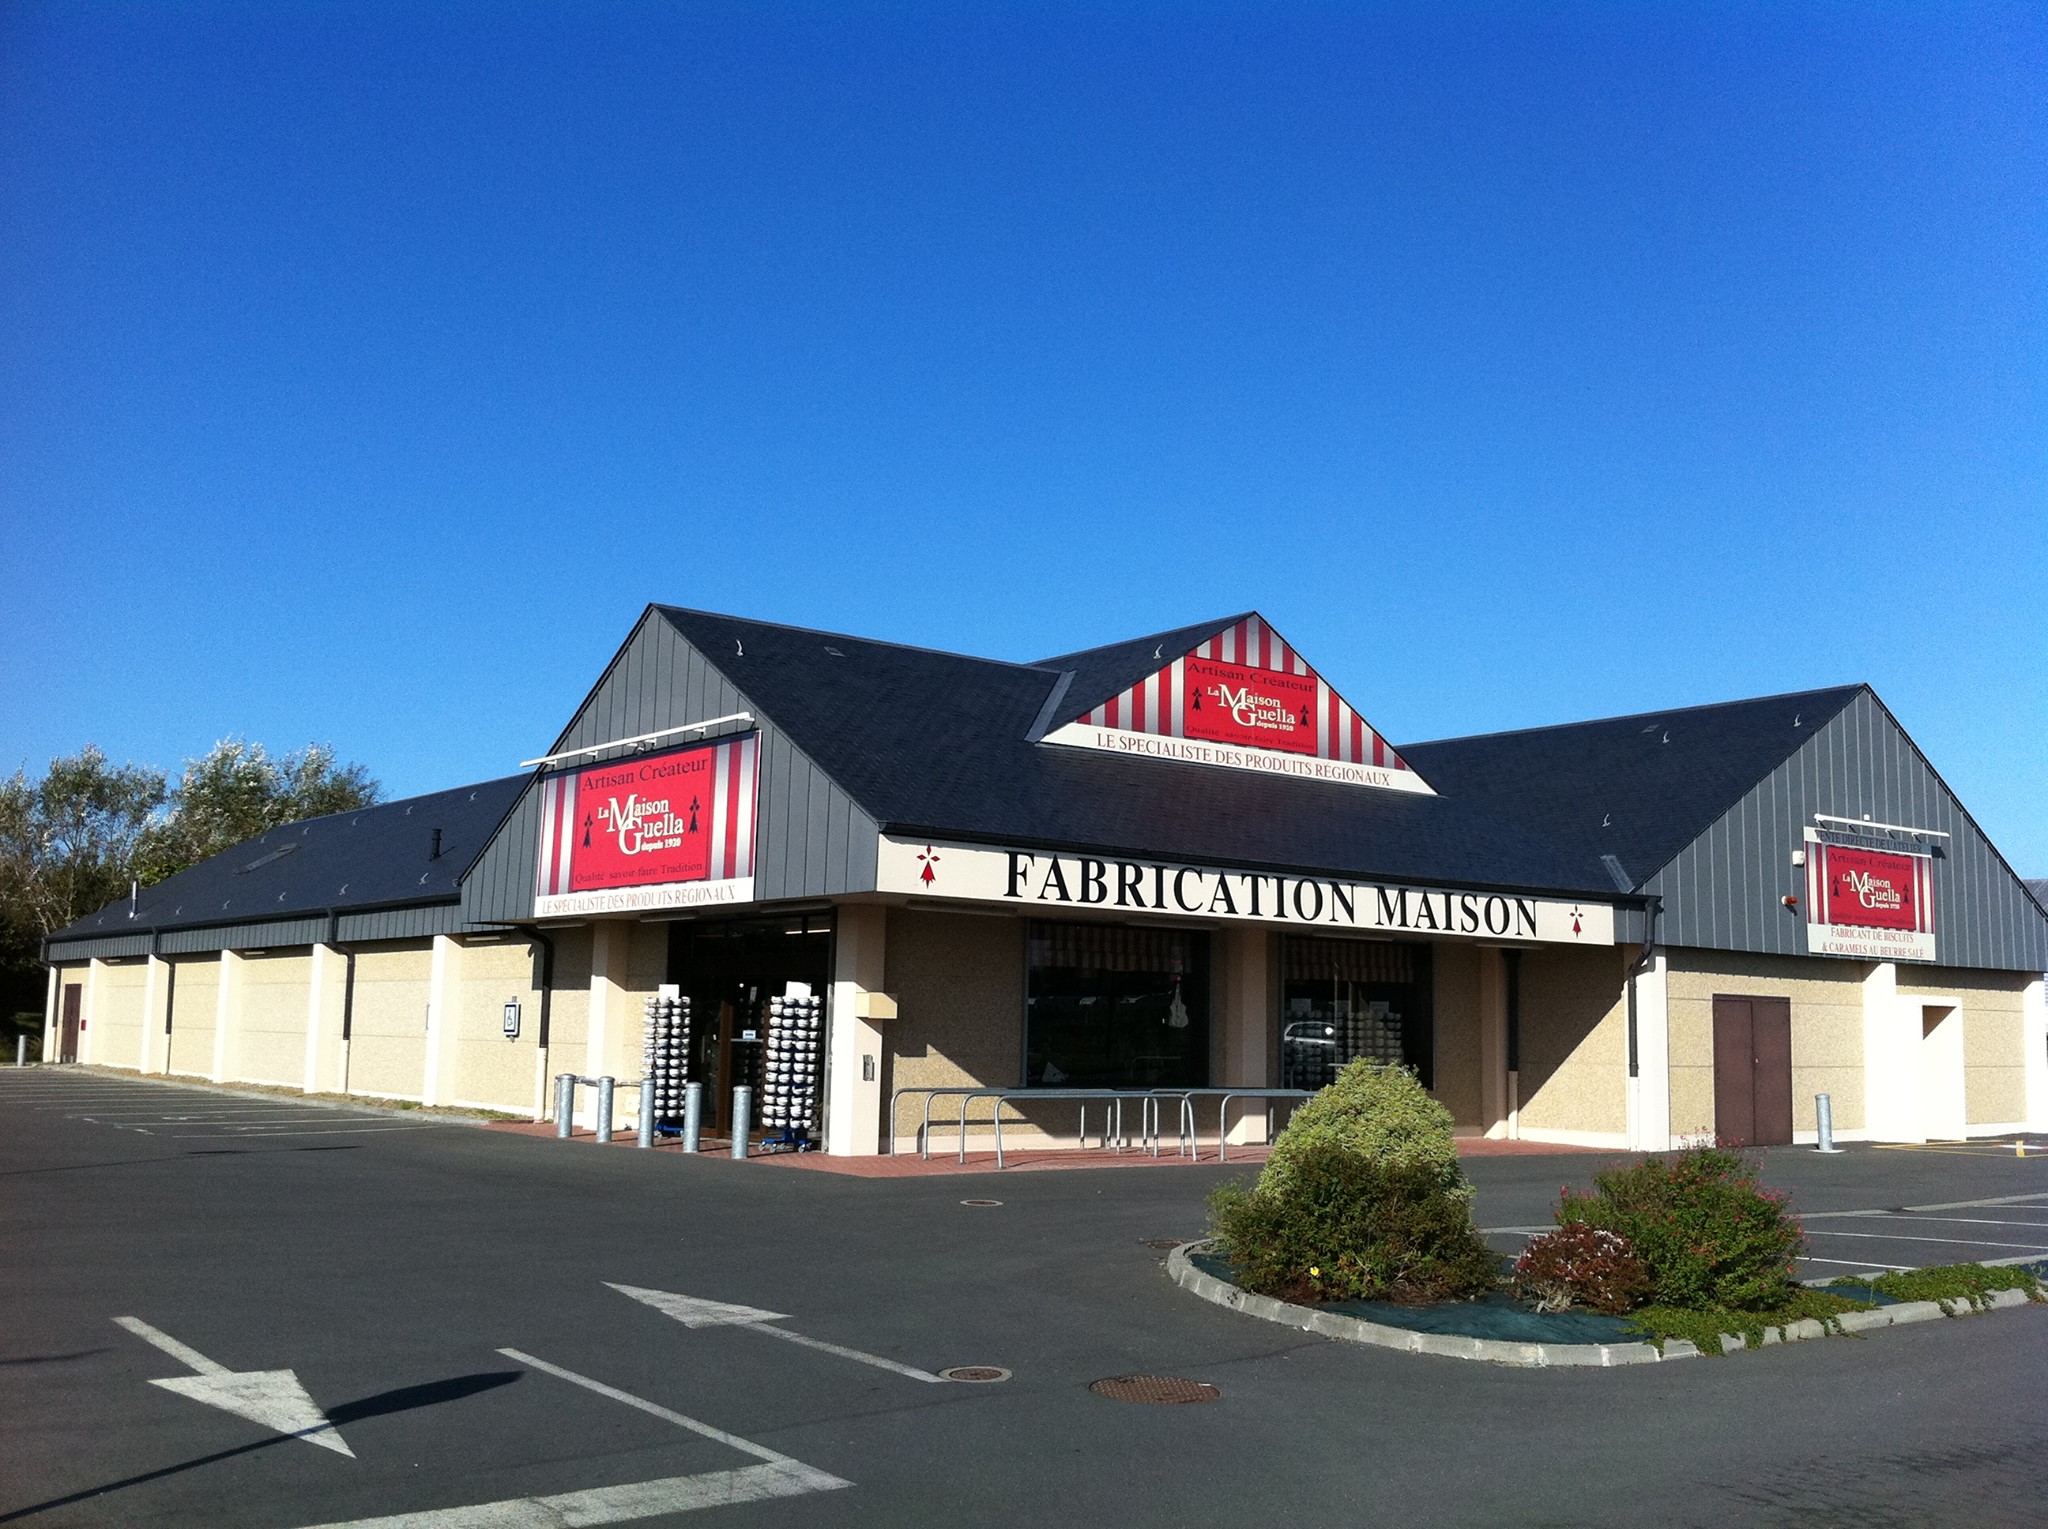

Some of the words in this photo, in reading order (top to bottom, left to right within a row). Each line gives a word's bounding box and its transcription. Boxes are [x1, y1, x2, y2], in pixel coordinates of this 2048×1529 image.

[1187, 662, 1245, 681] Artisan
[1250, 672, 1315, 693] Créateur
[1207, 687, 1219, 696] La
[1218, 684, 1281, 711] Maison
[1232, 702, 1296, 727] Guella
[1256, 720, 1278, 729] depuis
[1097, 733, 1116, 748] LE
[1119, 735, 1212, 762] SPECIALISTE
[1216, 749, 1242, 766] DES
[1245, 753, 1312, 776] PRODUITS
[1315, 763, 1390, 787] RÉGIONAUX
[582, 772, 634, 792] Artisan
[639, 757, 708, 781] Créateur
[597, 807, 609, 819] La
[606, 794, 669, 832] Maison
[619, 812, 684, 855] Guella
[641, 842, 663, 852] depuis
[1828, 853, 1866, 866] Artisan
[575, 870, 605, 884] Qualité
[661, 862, 703, 875] Tradition
[1842, 874, 1850, 882] La
[1849, 870, 1890, 893] Maison
[542, 900, 552, 914] LE
[553, 896, 605, 914] SPECIALISTE
[607, 893, 624, 910] DES
[626, 890, 673, 908] PRODUITS
[1003, 850, 1357, 924] FABRICATION
[1374, 885, 1538, 938] MAISON
[1859, 886, 1900, 908] Guella
[1830, 927, 1871, 940] FABRICANT
[1873, 930, 1882, 941] DE
[1884, 932, 1914, 943] BISCUITS
[1822, 942, 1828, 951] &
[1829, 942, 1867, 955] CARAMELS
[1869, 946, 1878, 956] AU
[1880, 946, 1906, 957] BEURRE
[1907, 947, 1924, 959] SALÉ
